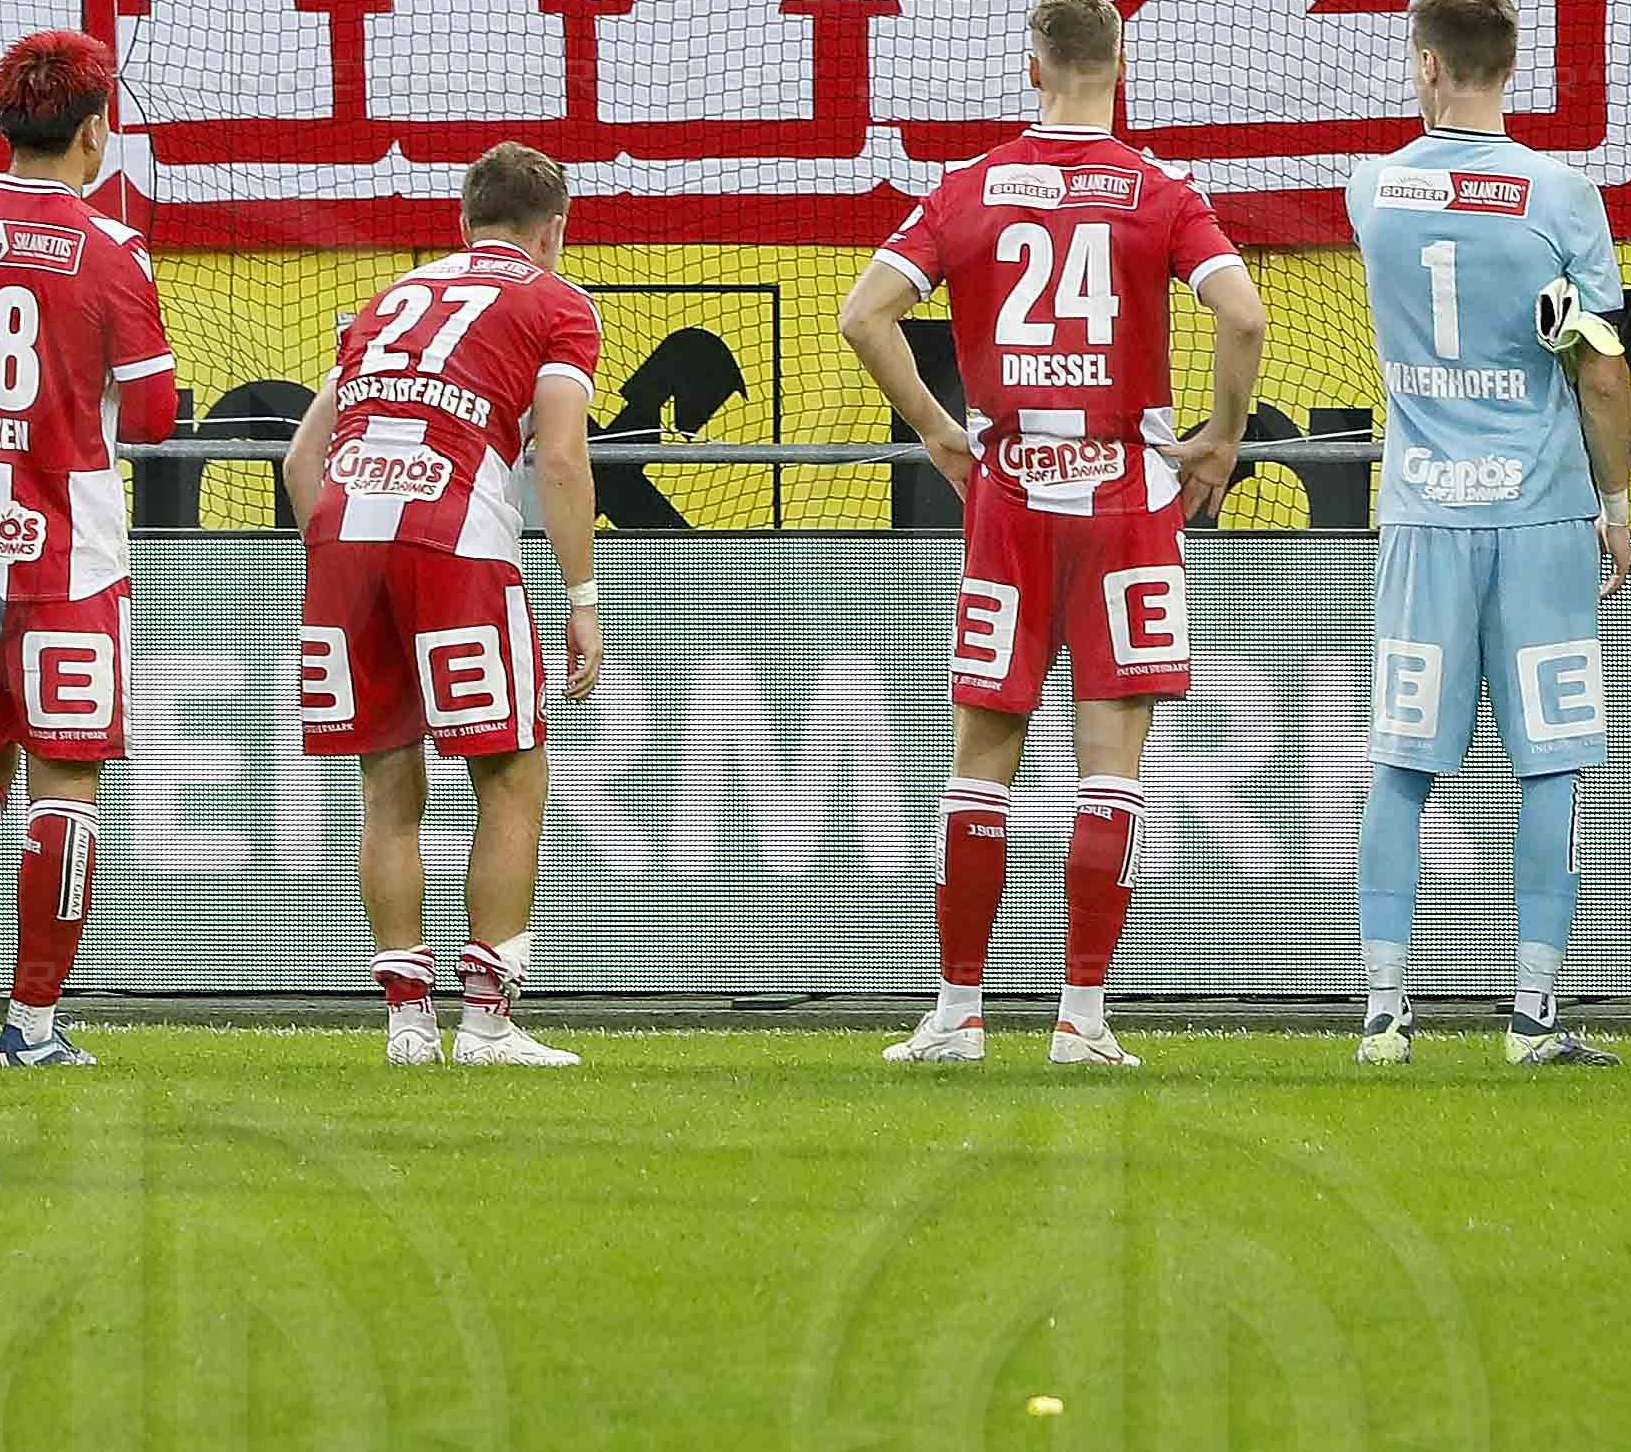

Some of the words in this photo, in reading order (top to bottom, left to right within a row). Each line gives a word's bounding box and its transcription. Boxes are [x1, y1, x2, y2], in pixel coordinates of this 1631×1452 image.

[992, 184, 1058, 199] SORGER
[1070, 175, 1135, 196] SALANETTIS
[1380, 185, 1448, 203] SORGER
[1460, 177, 1526, 204] SALANETTIS
[11, 228, 76, 260] SALANETTIS
[995, 222, 1118, 345] 24
[1421, 239, 1460, 361] 1
[359, 284, 504, 377] 27
[1002, 353, 1113, 386] DRESSEL
